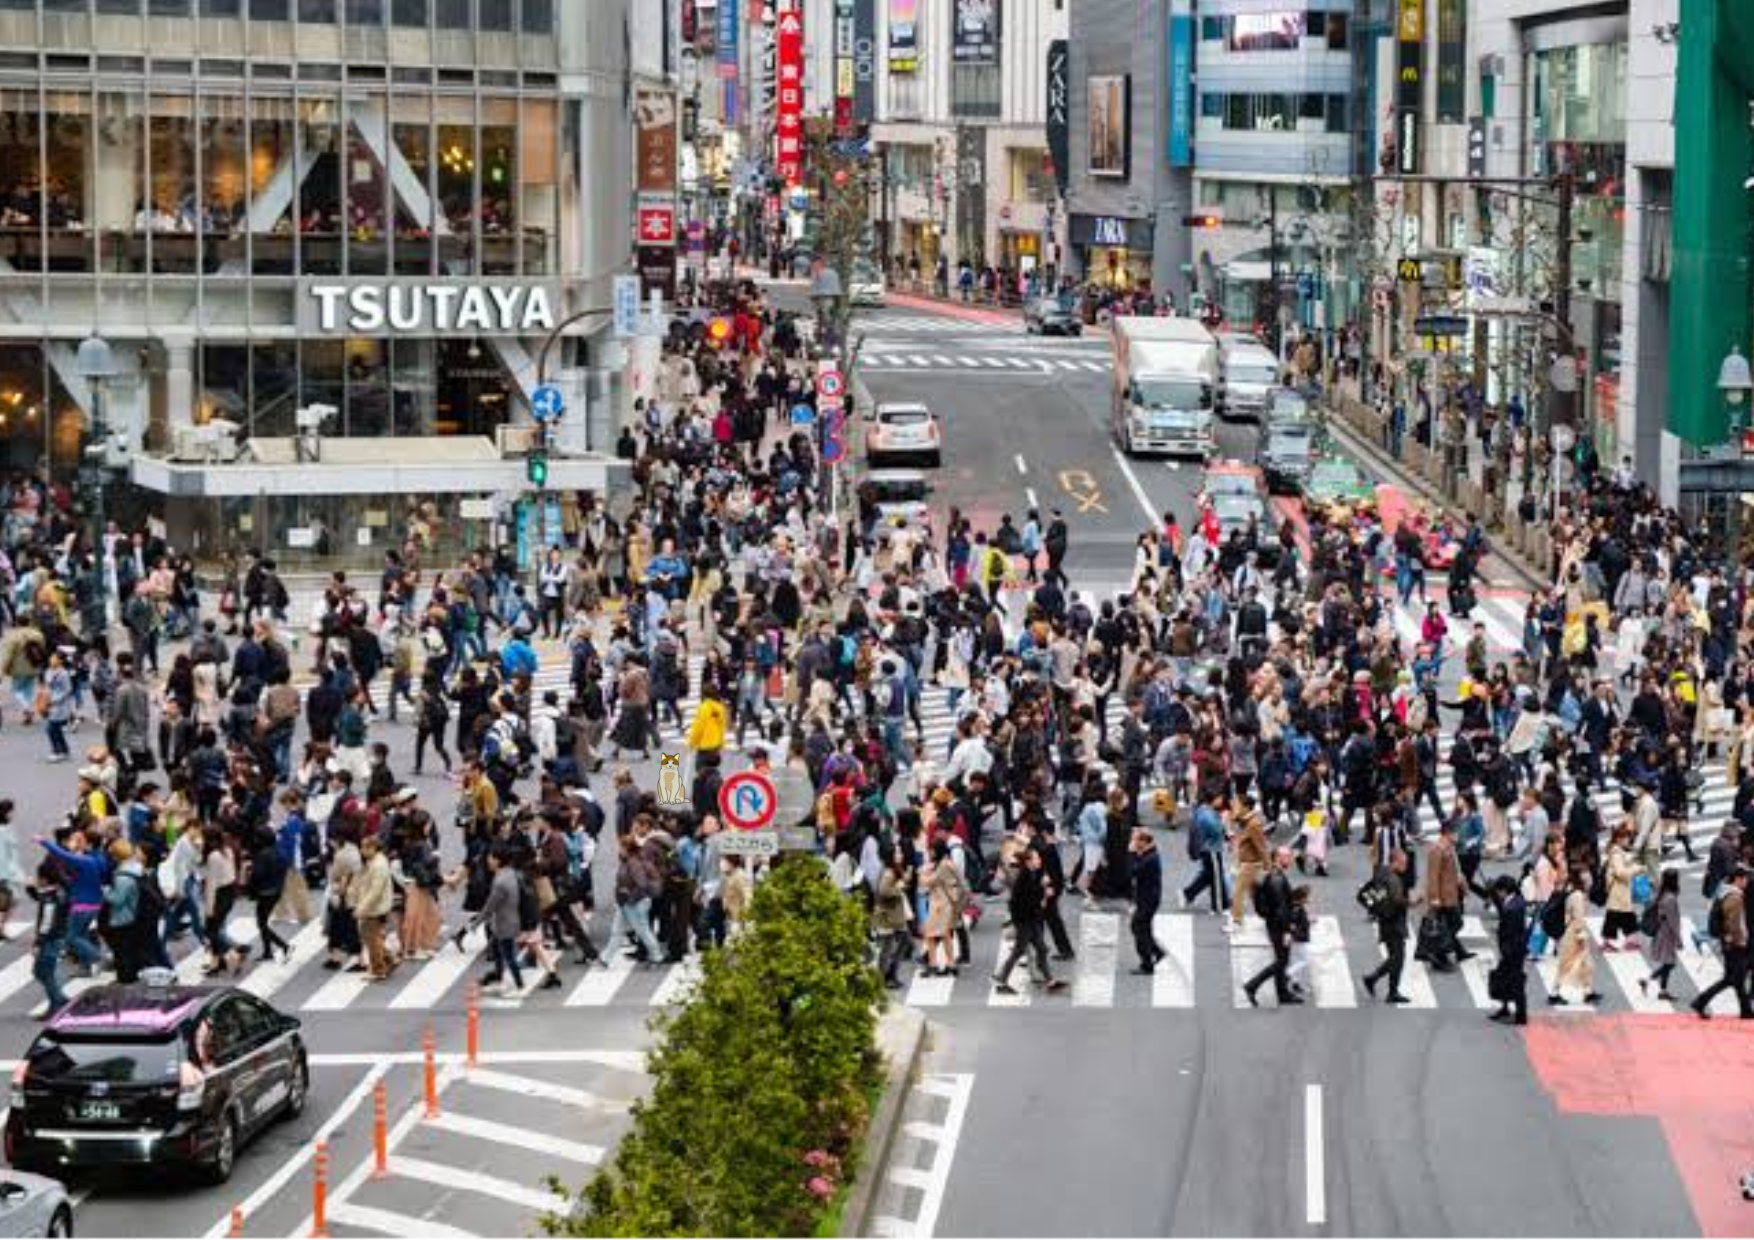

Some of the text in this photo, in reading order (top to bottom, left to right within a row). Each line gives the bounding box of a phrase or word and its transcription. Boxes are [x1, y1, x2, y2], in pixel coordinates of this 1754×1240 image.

[1050, 53, 1065, 124] ZARA
[311, 285, 554, 330] TSUTAYA
[723, 837, 773, 851] ここから
